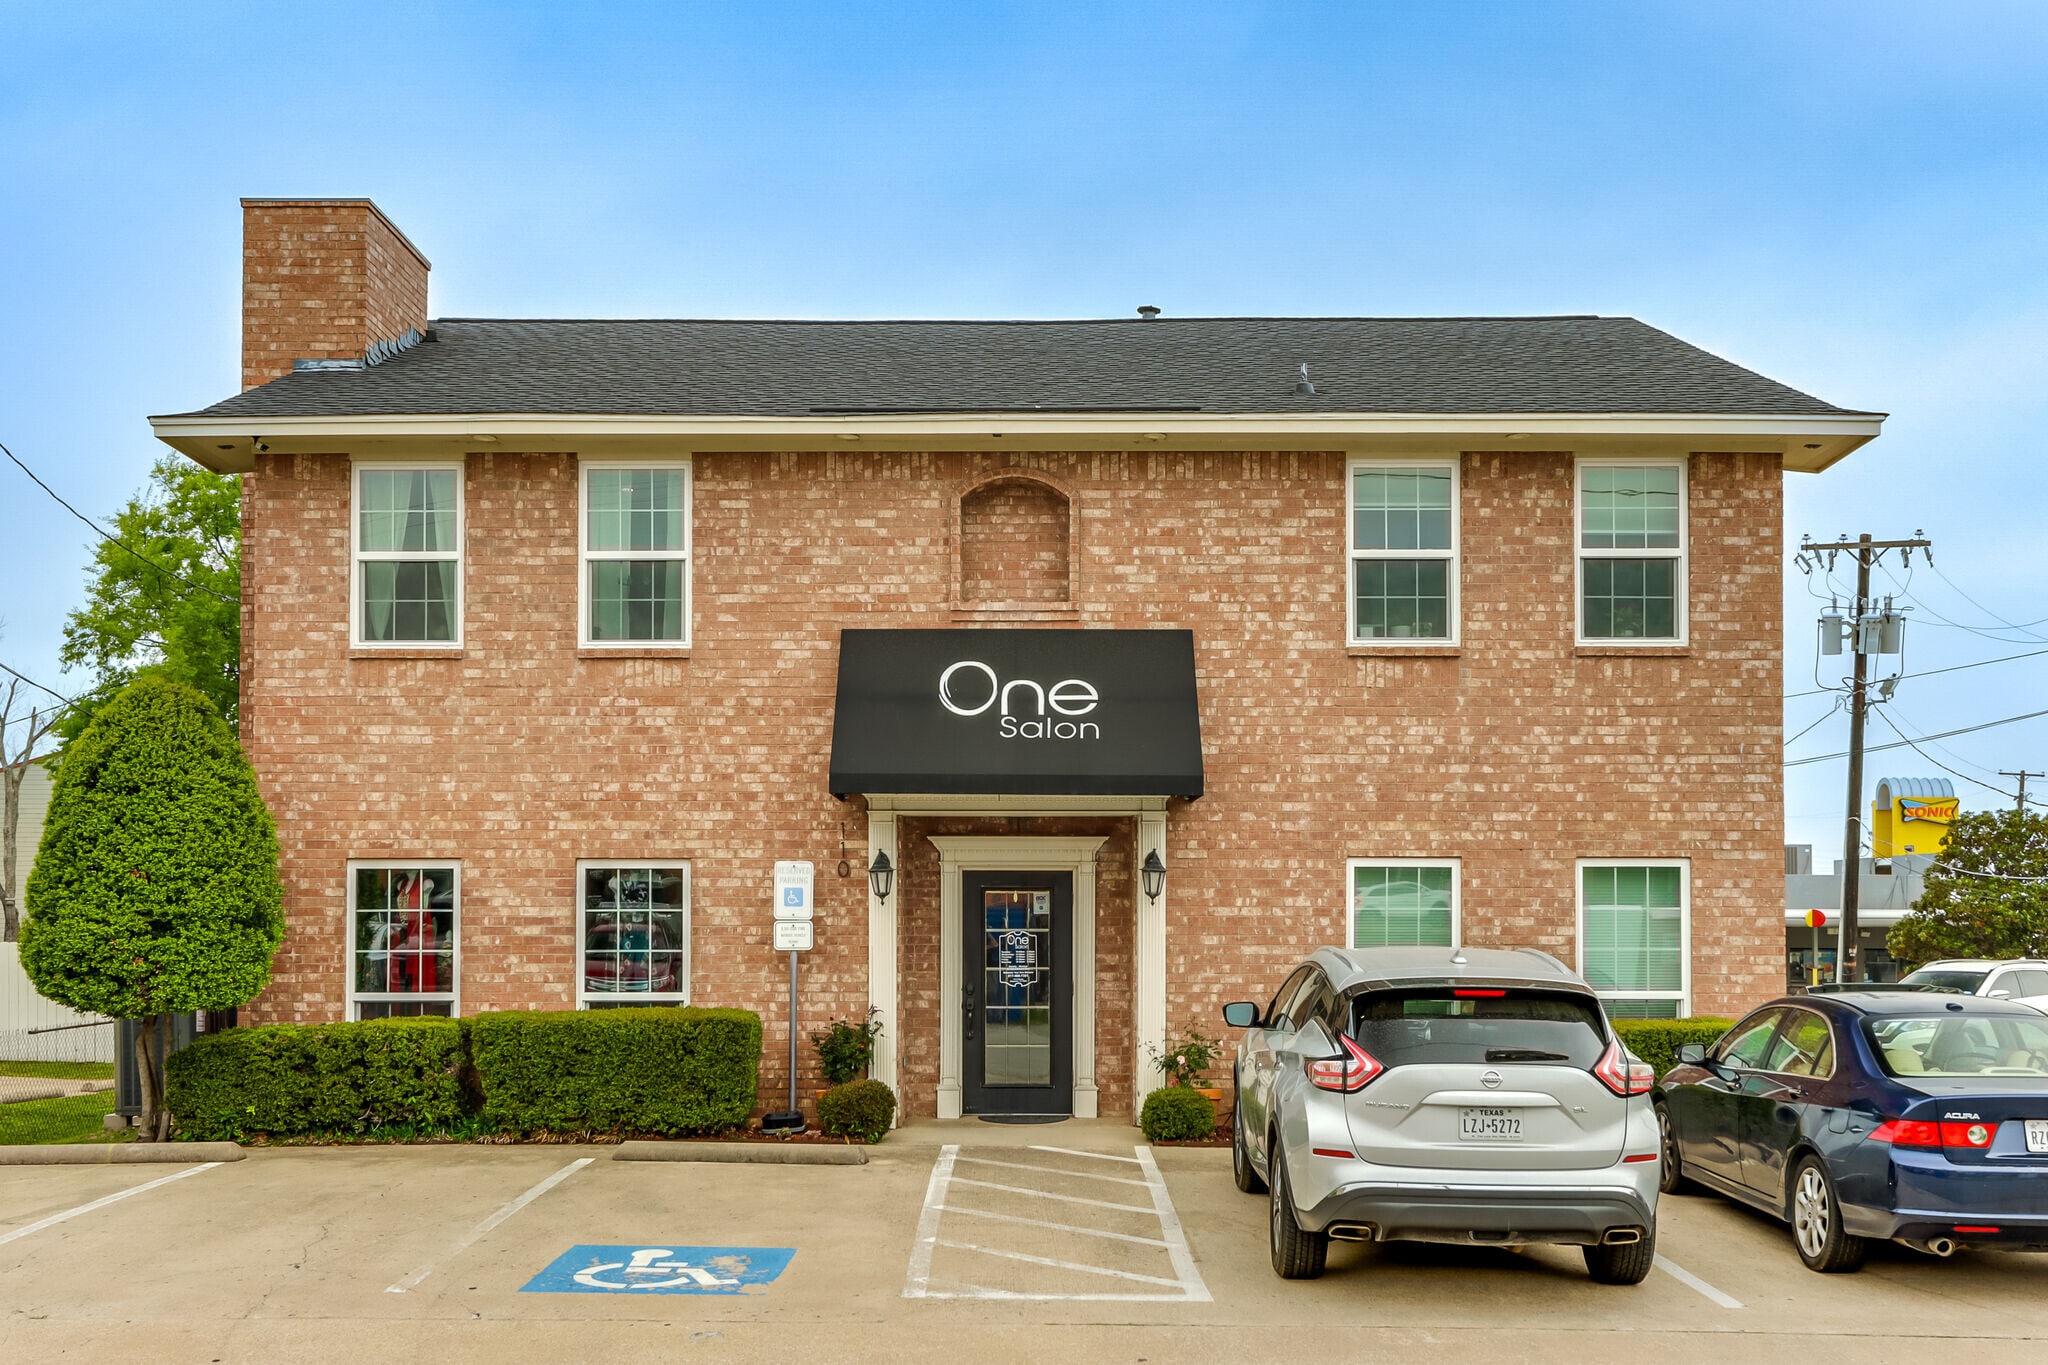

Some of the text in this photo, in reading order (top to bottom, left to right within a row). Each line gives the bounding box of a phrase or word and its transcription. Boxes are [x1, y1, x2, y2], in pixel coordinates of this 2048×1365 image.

[938, 660, 1099, 716] One
[1000, 716, 1100, 739] Salon
[1906, 806, 1954, 818] SONIC
[779, 876, 809, 885] PARKING
[1007, 934, 1030, 946] One
[1365, 1100, 1410, 1111] MURANO
[1944, 1112, 1981, 1120] ACURA
[2031, 1131, 2048, 1145] RZ
